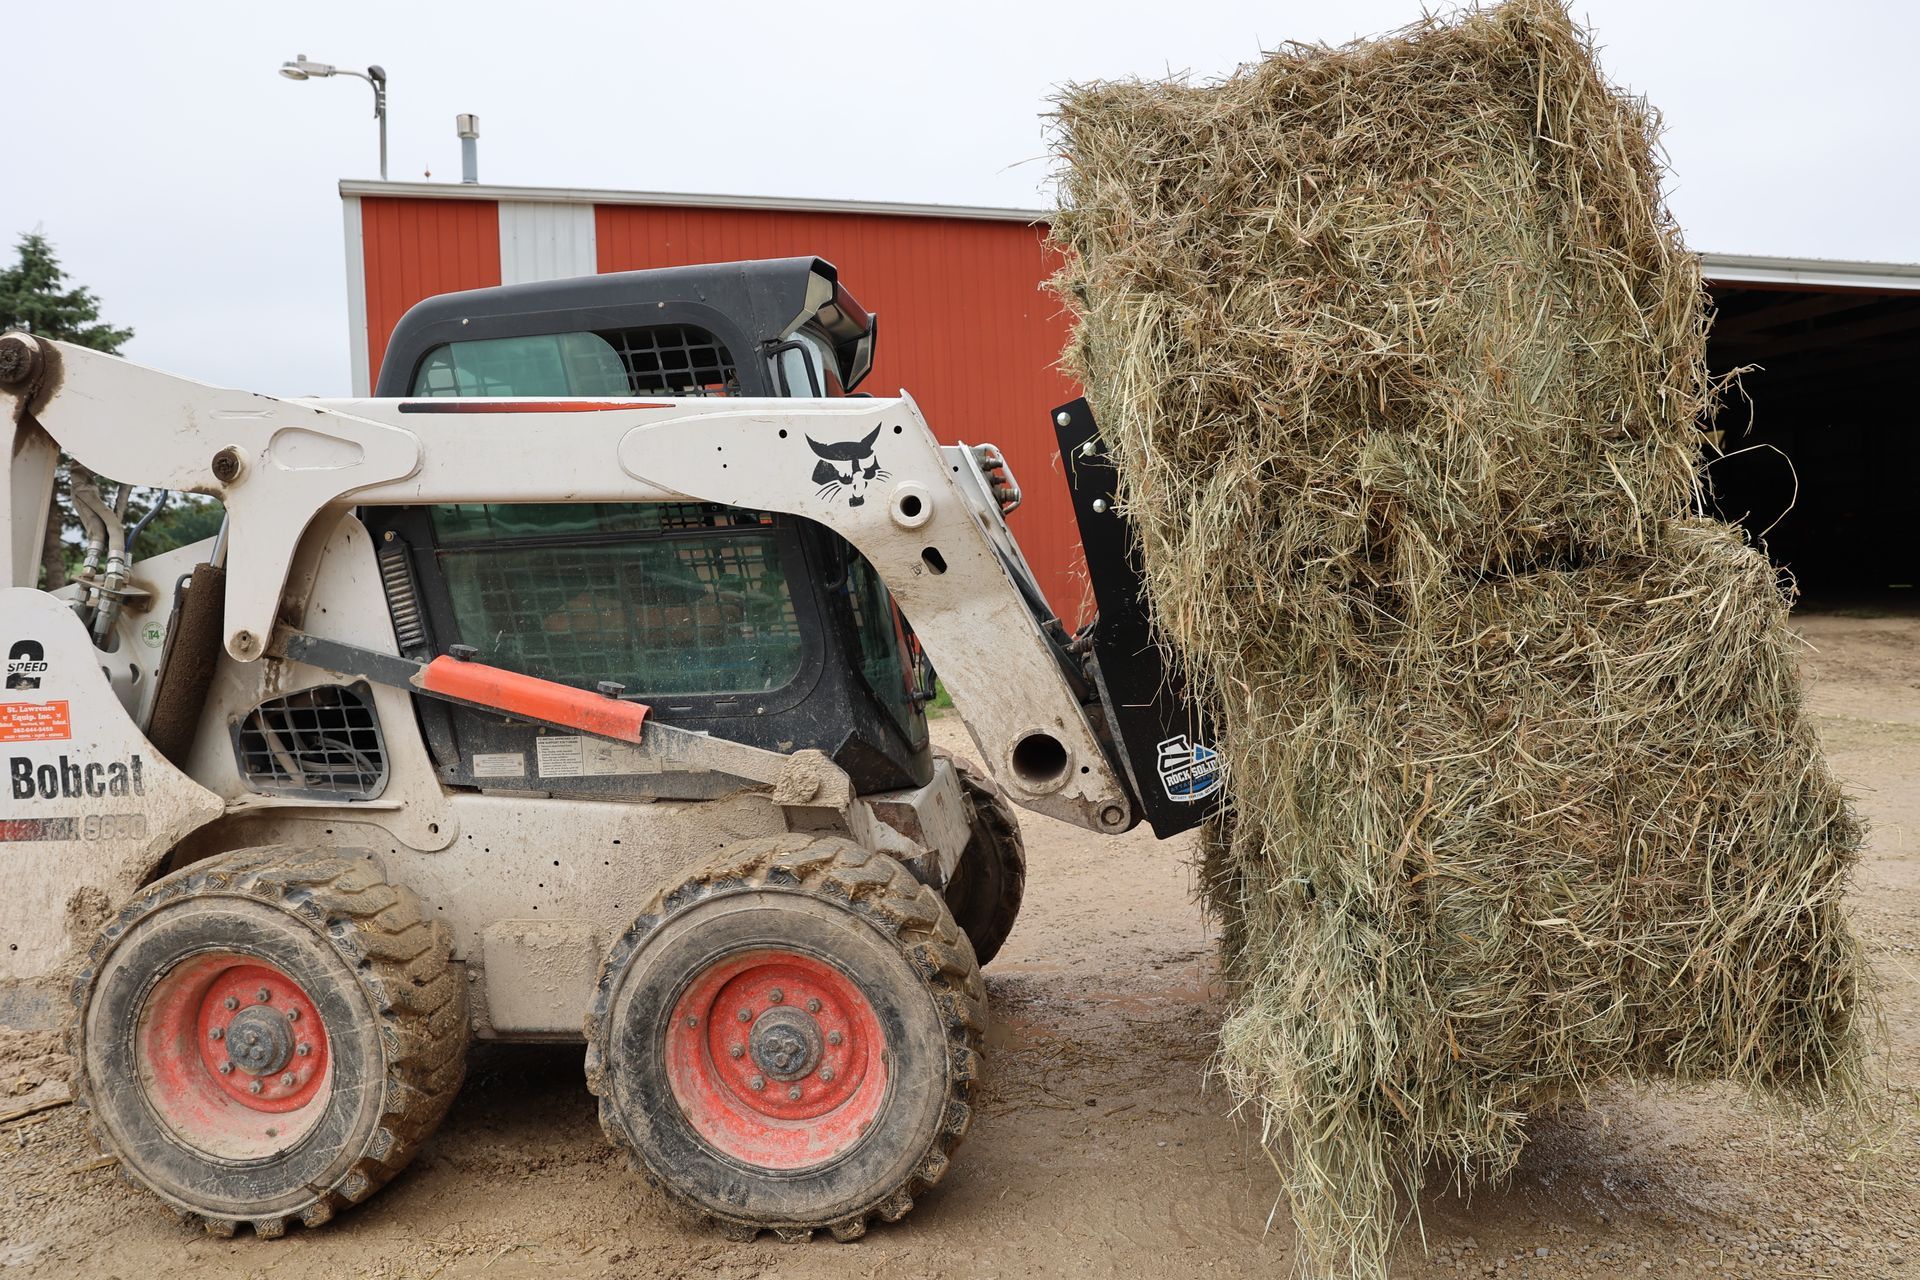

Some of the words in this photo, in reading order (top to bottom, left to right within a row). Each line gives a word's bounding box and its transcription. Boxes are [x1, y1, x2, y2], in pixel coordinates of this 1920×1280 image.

[7, 662, 48, 672] SPEED
[10, 755, 145, 799] Bobcat
[1166, 769, 1191, 787] ROCK
